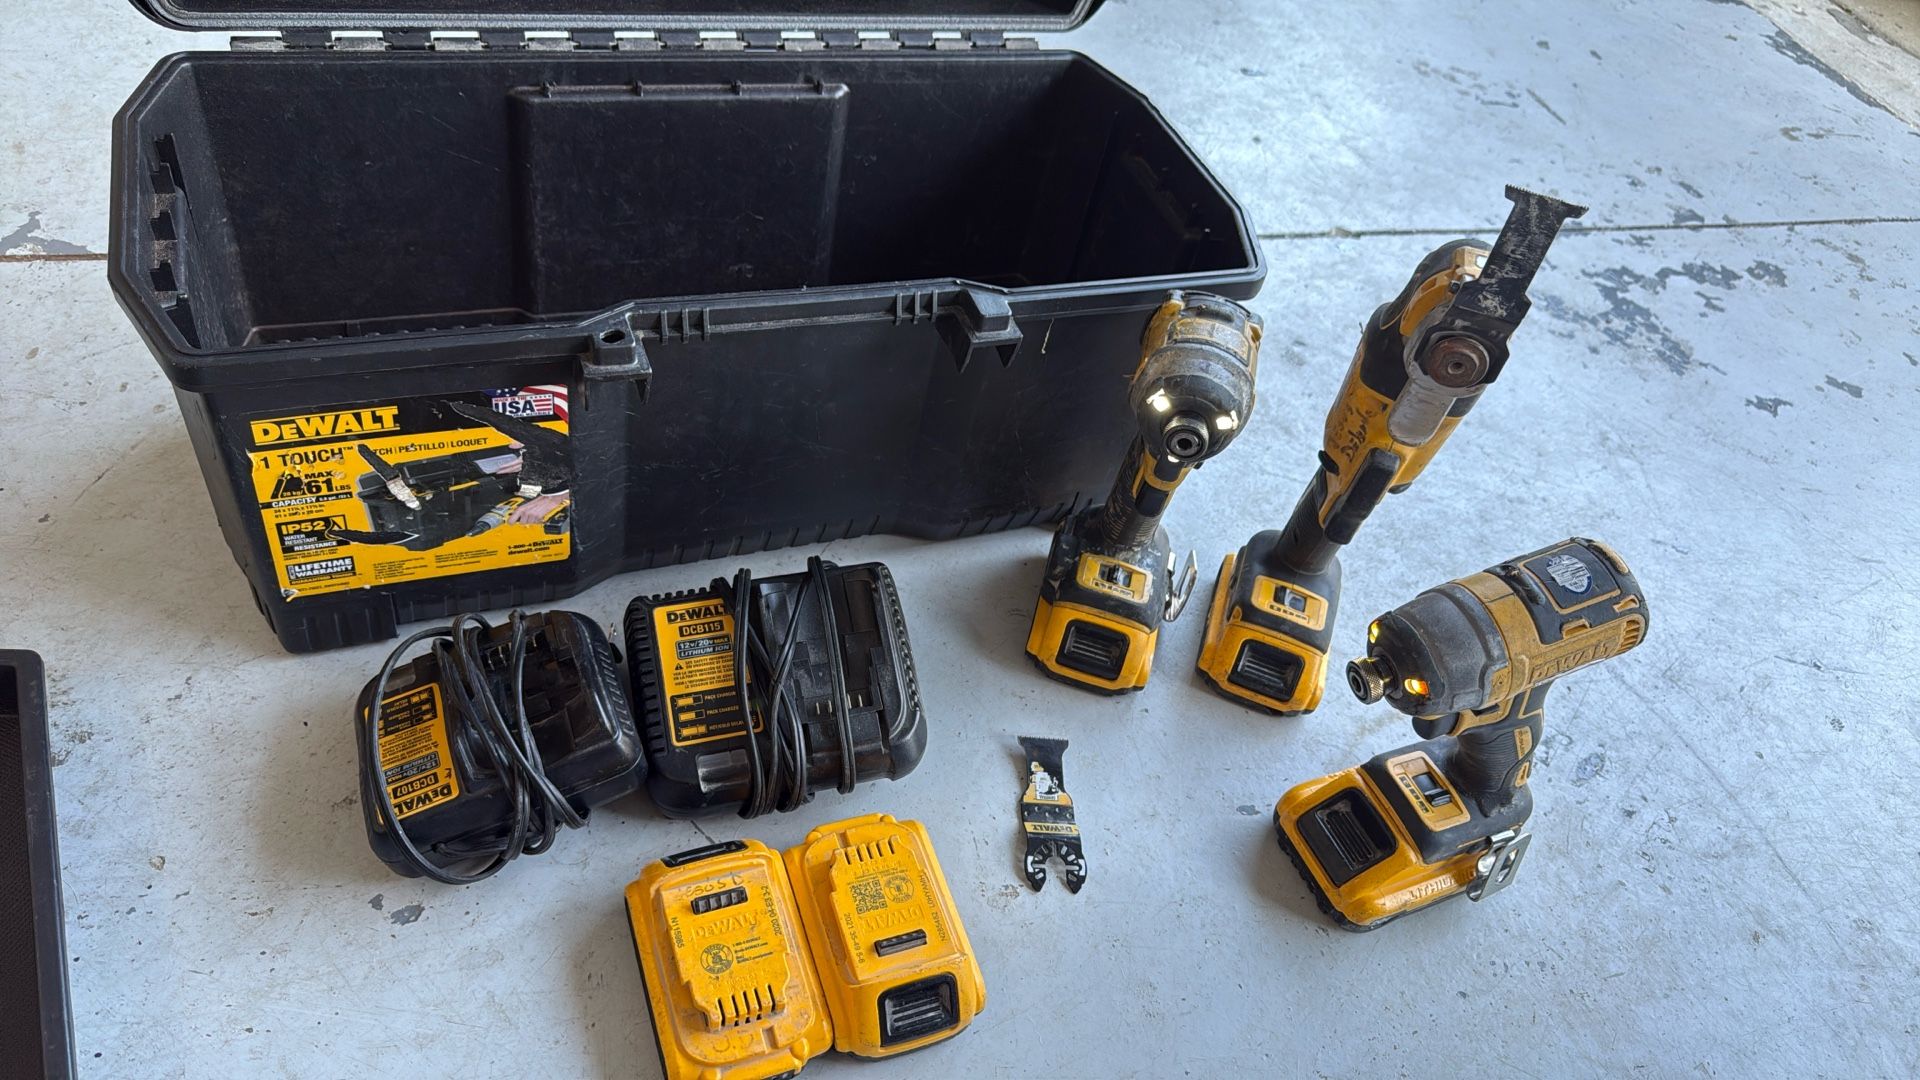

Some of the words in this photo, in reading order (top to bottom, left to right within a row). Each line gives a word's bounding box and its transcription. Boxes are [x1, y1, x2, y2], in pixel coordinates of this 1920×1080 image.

[494, 400, 535, 414] USA
[251, 408, 398, 443] DEWALT
[400, 442, 445, 453] PESTILLO
[451, 438, 488, 448] LOQUET
[260, 456, 270, 469] 1
[304, 470, 334, 480] MAX
[305, 478, 334, 495] 61
[335, 484, 351, 492] LBS
[272, 497, 317, 508] CAPACITY
[281, 521, 326, 535] IP52
[285, 537, 318, 545] RESISTANT
[508, 546, 550, 555] dewalt.com
[296, 558, 352, 572] LIFETIME
[296, 565, 353, 577] WARRANTY
[667, 604, 725, 623] DEWAL
[682, 622, 721, 636] DCB115
[680, 647, 713, 657] LITHIUM
[715, 644, 730, 652] ION
[401, 754, 435, 769] LITHIUM
[385, 767, 401, 775] ION
[396, 775, 436, 796] DCB107
[394, 784, 452, 815] DEWAL
[1032, 823, 1072, 833] DEWALT
